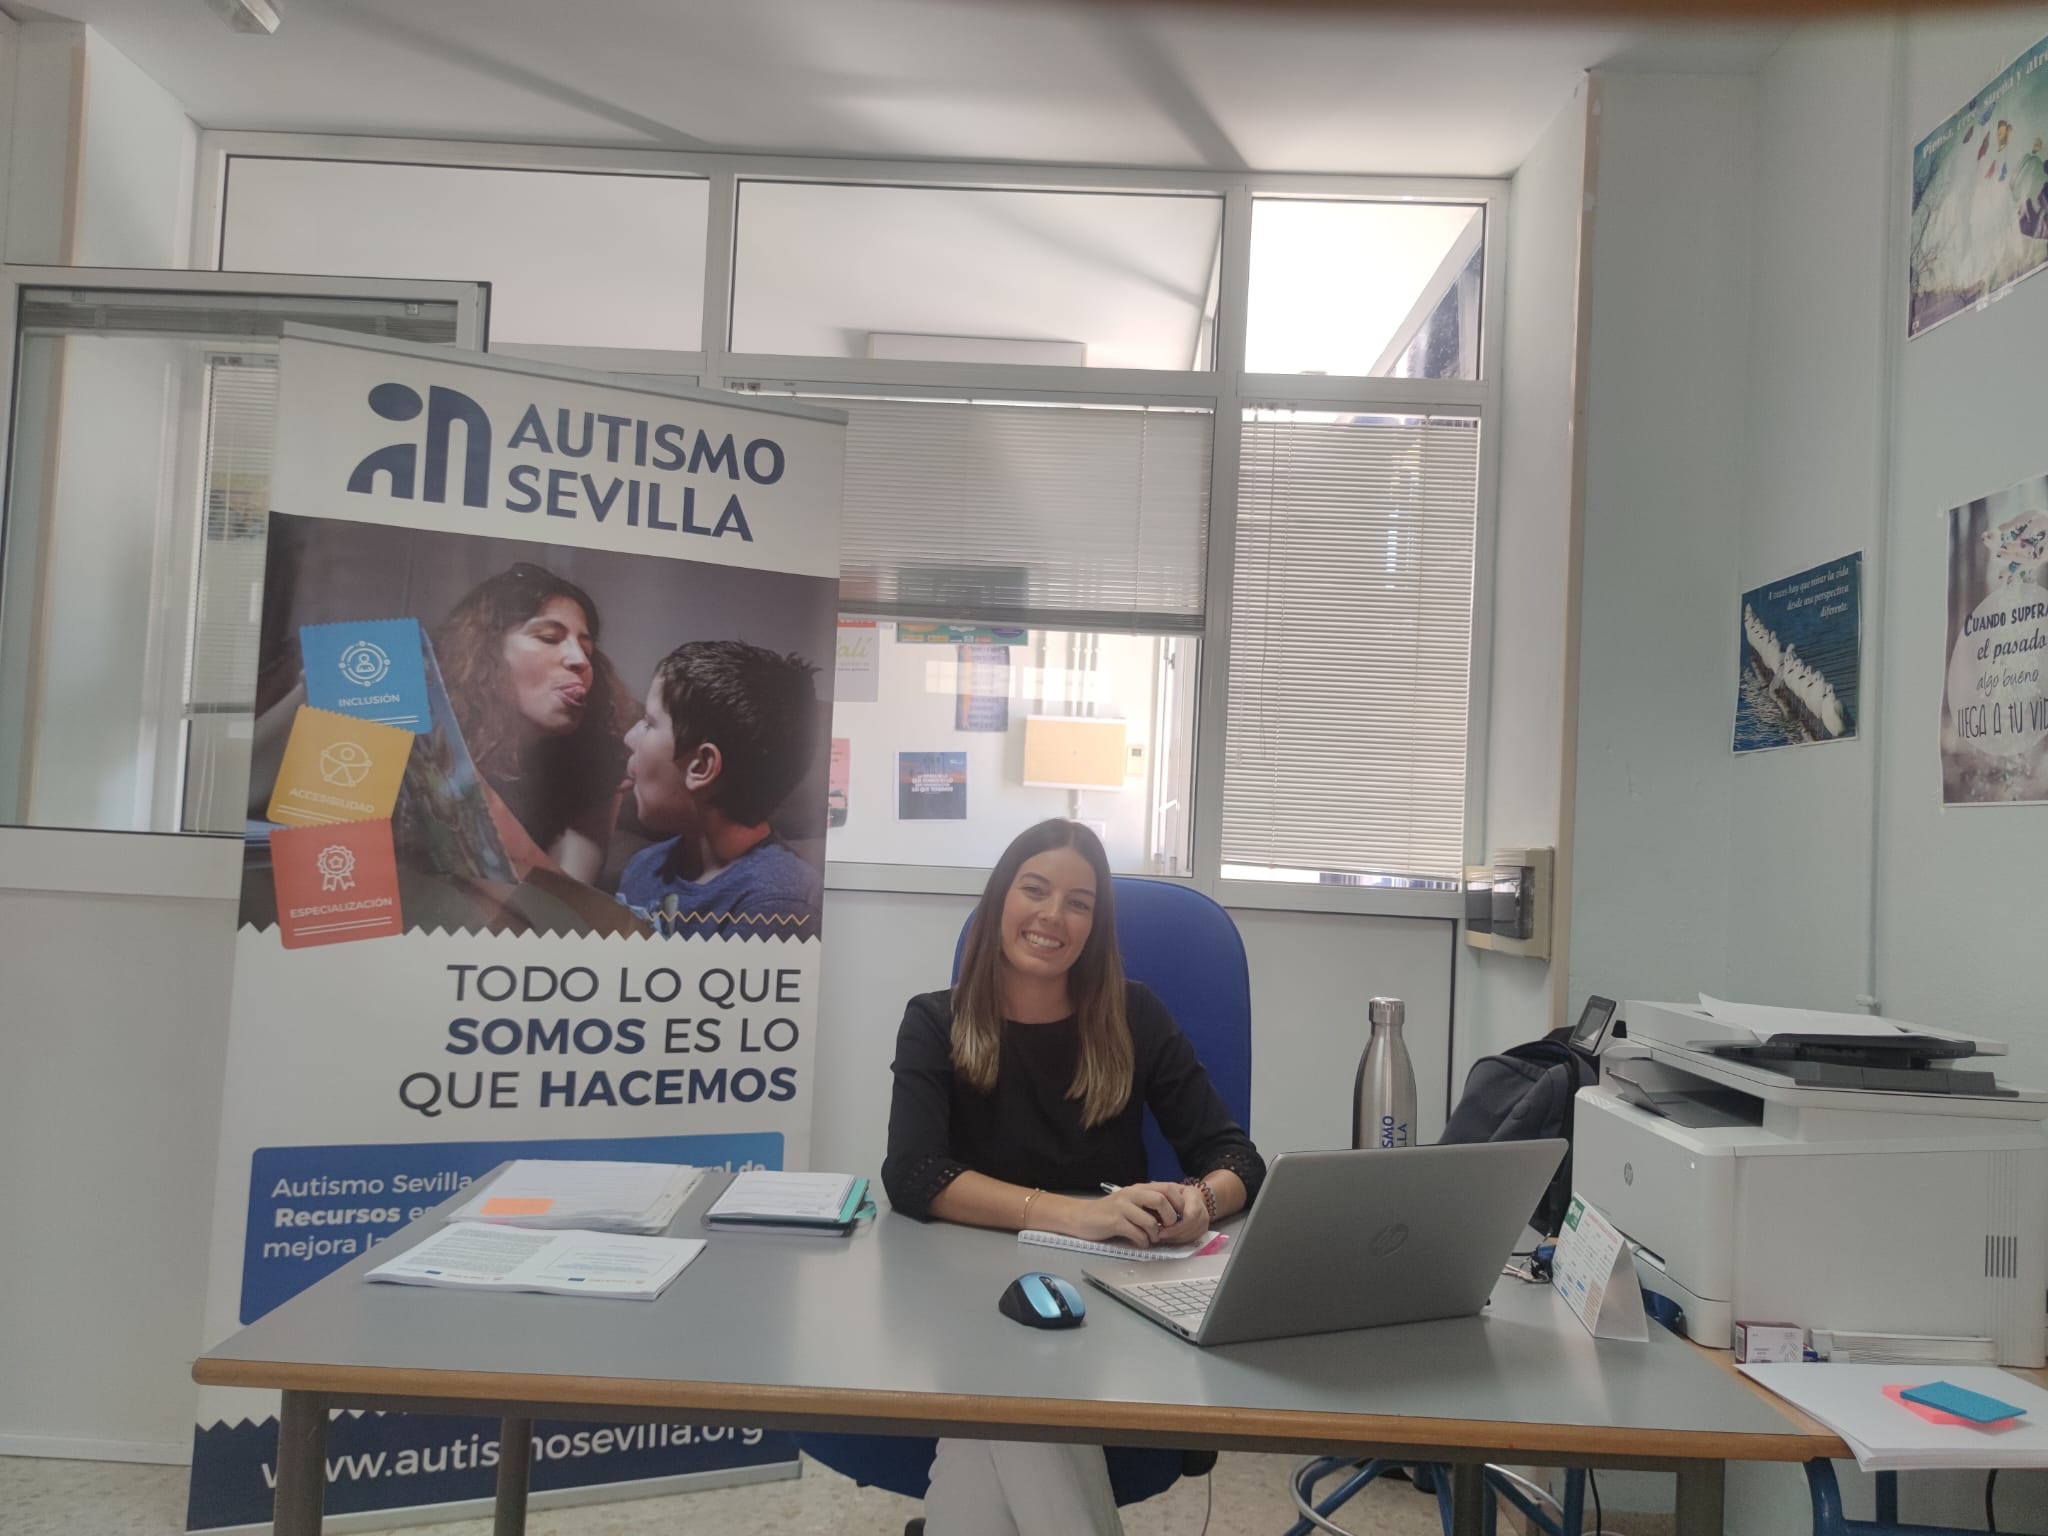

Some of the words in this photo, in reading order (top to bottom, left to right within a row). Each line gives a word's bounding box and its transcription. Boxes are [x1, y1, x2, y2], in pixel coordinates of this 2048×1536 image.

[507, 403, 785, 485] AUTISMO
[506, 464, 754, 542] SEVILLA
[1977, 638, 1990, 660] el
[1993, 627, 2048, 664] pasado
[1976, 672, 1999, 697] algo
[2002, 668, 2039, 687] bueno
[338, 694, 400, 708] INCLUSIÓN
[1994, 702, 2002, 735] A
[288, 787, 375, 814] ACCESIBILIDAD
[290, 897, 393, 918] ESPECIALIZACIÓN
[446, 964, 600, 1002] TODO
[619, 967, 682, 1003] LO
[699, 967, 801, 1010] QUE
[445, 1017, 647, 1055] SOMOS
[664, 1018, 722, 1053] ES
[740, 1017, 800, 1053] LO
[399, 1071, 520, 1118] QUE
[540, 1066, 798, 1108] HACEMOS
[271, 1176, 385, 1198] Autismo
[391, 1171, 473, 1194] Sevilla
[274, 1206, 401, 1228] Recursos
[408, 1205, 434, 1223] e
[263, 1235, 357, 1261] mejora
